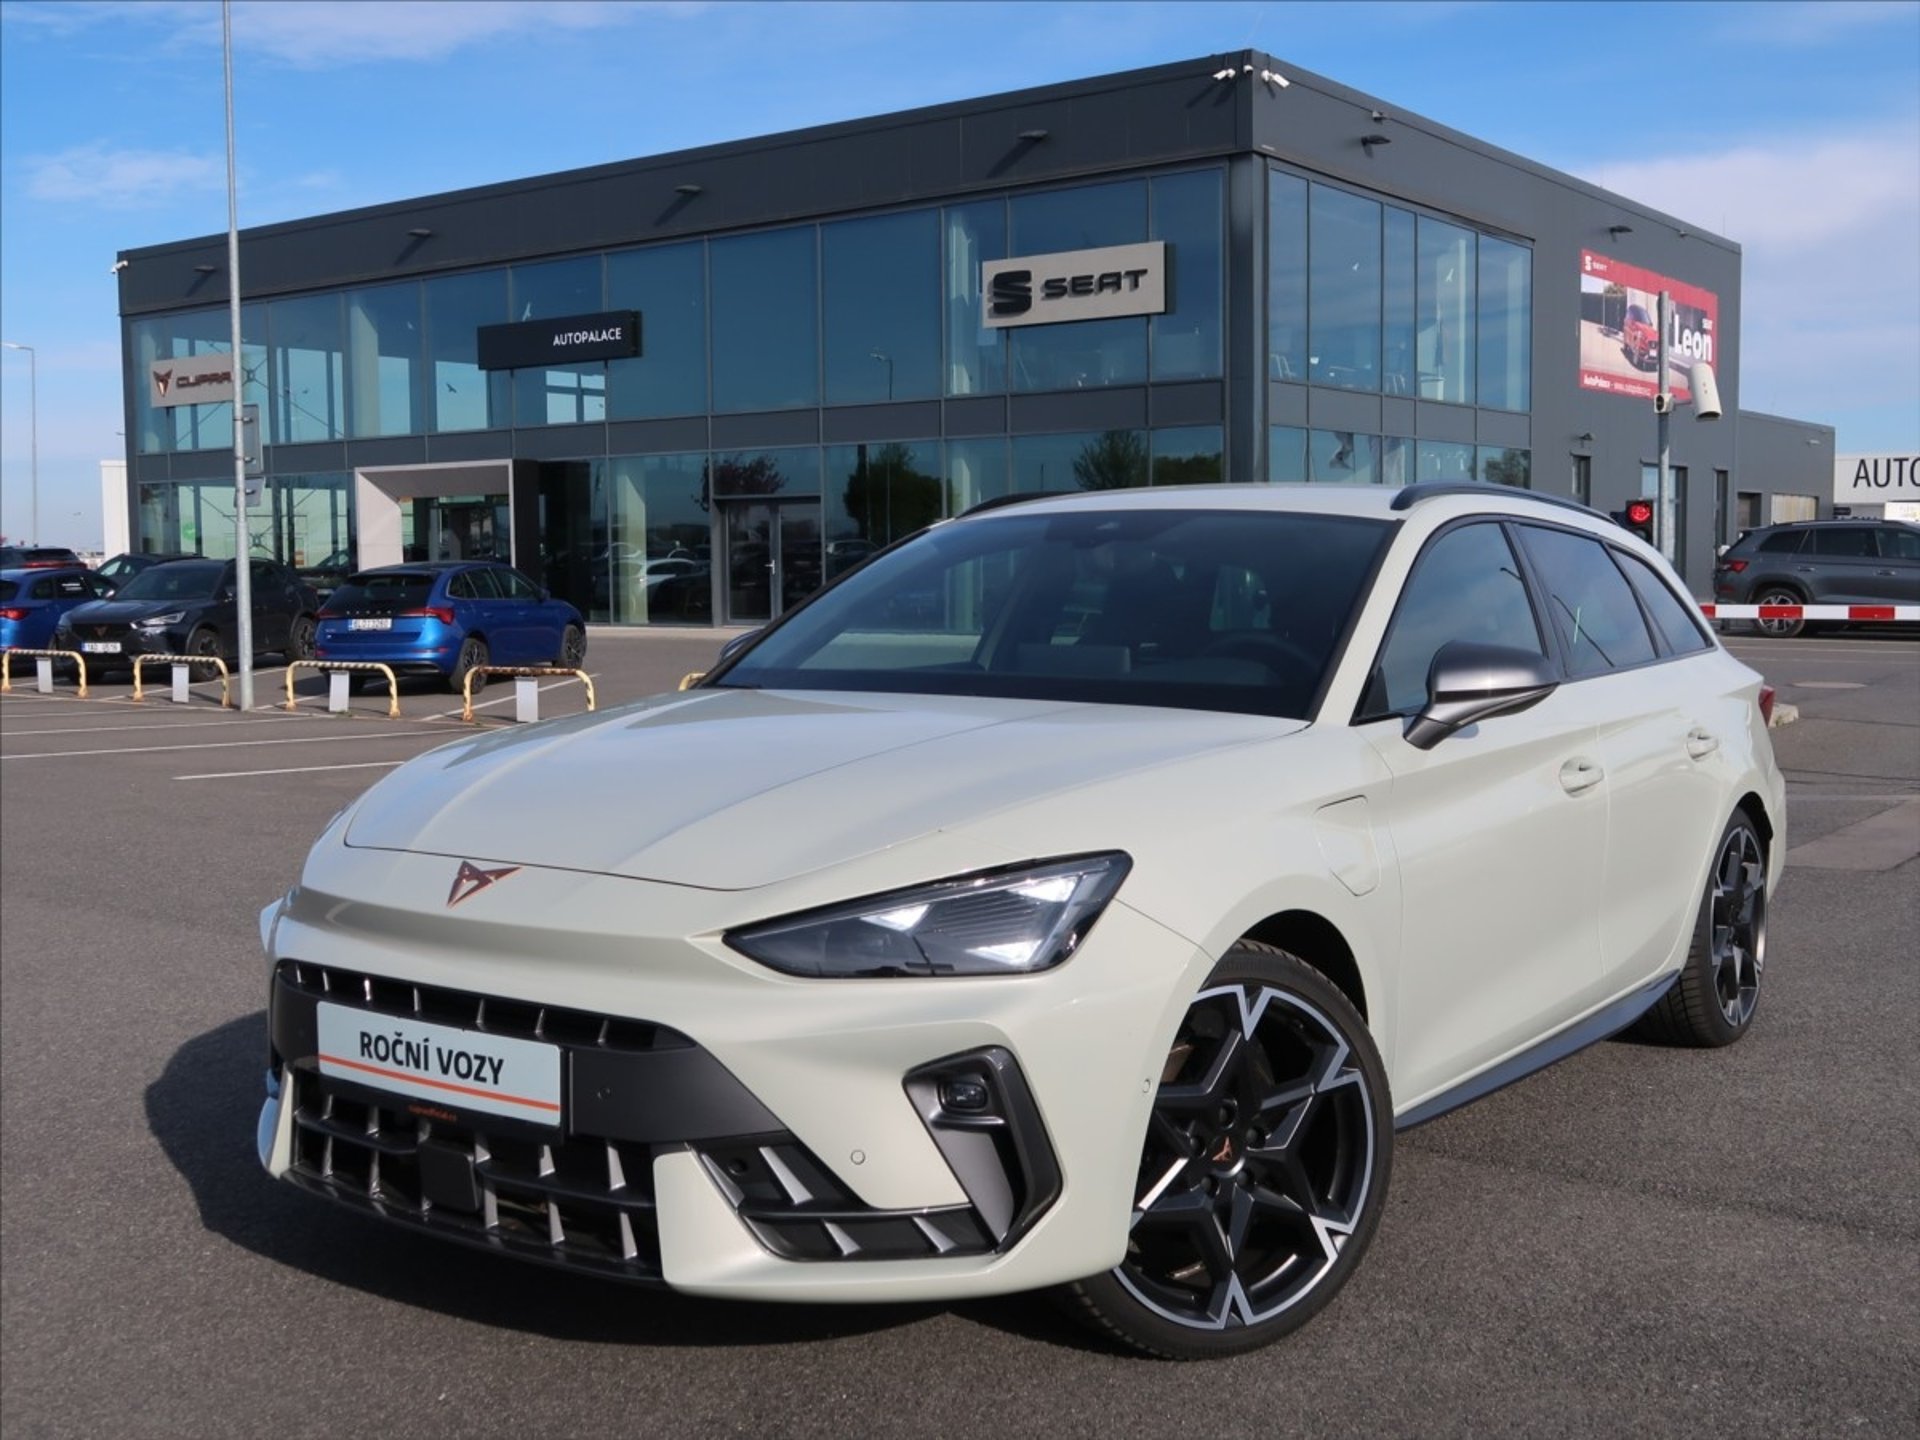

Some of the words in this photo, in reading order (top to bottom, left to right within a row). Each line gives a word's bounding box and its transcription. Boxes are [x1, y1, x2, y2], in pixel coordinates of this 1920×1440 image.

[1043, 268, 1149, 299] SEAT
[552, 327, 622, 346] AUTOPALACE
[1674, 314, 1713, 363] Leon
[359, 1030, 430, 1071] ROČNÍ
[436, 1047, 504, 1085] VOZY
